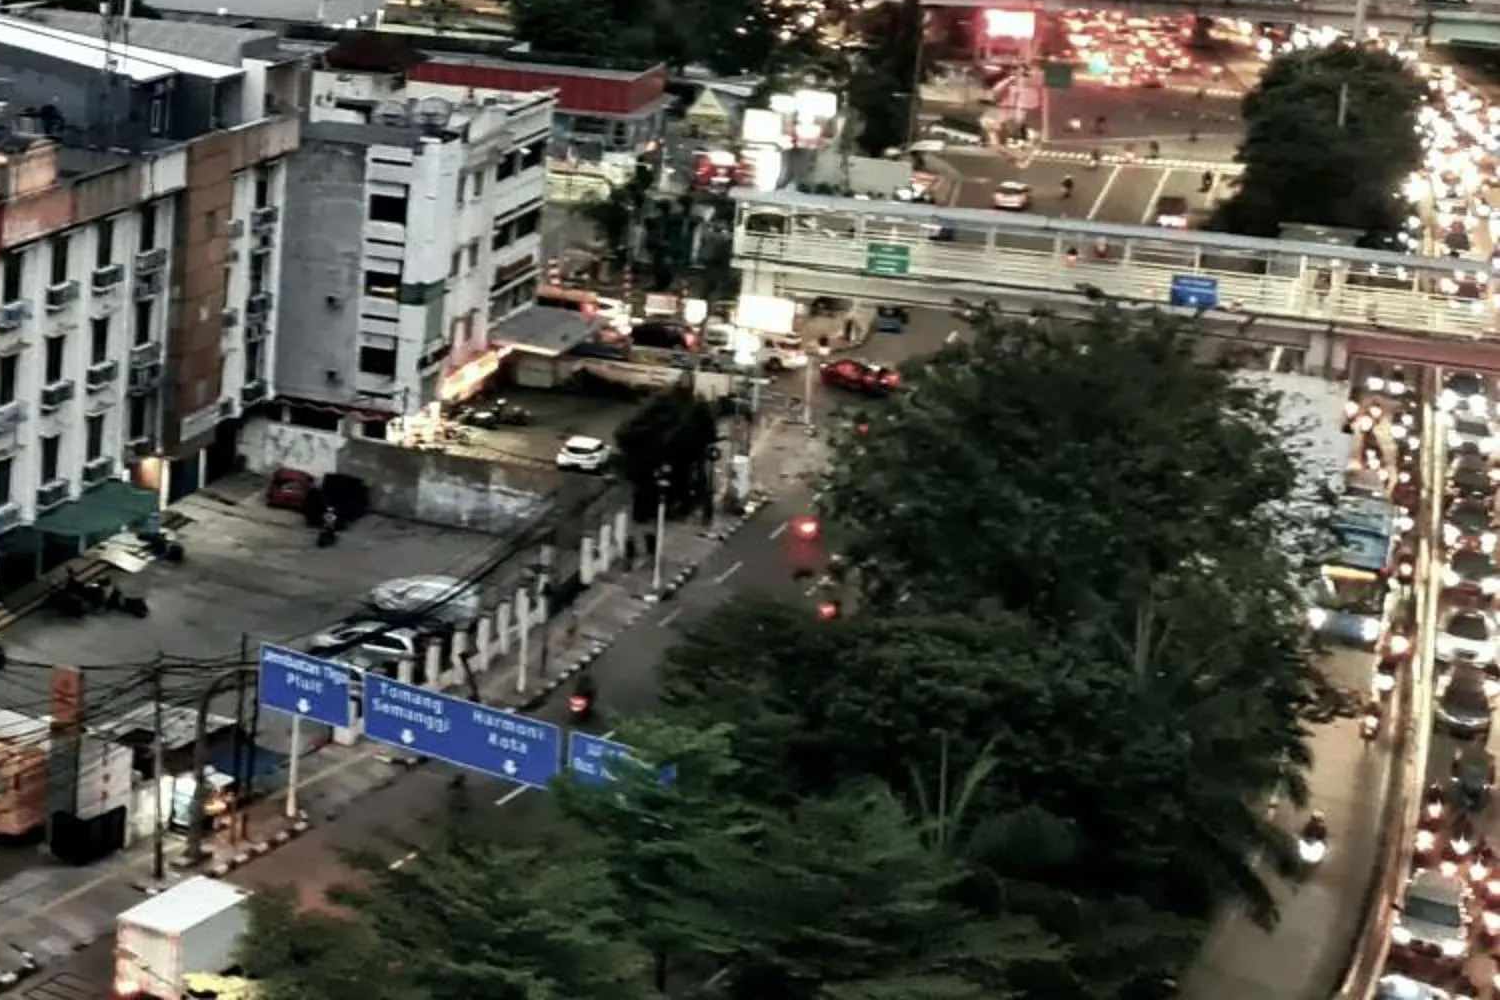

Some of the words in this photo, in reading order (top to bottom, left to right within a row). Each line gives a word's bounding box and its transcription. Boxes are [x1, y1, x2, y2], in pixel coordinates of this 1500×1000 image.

[379, 682, 444, 715] Tomang
[372, 698, 450, 733] Semanggi
[473, 710, 547, 741] Harmoni
[488, 732, 528, 755] Kota
